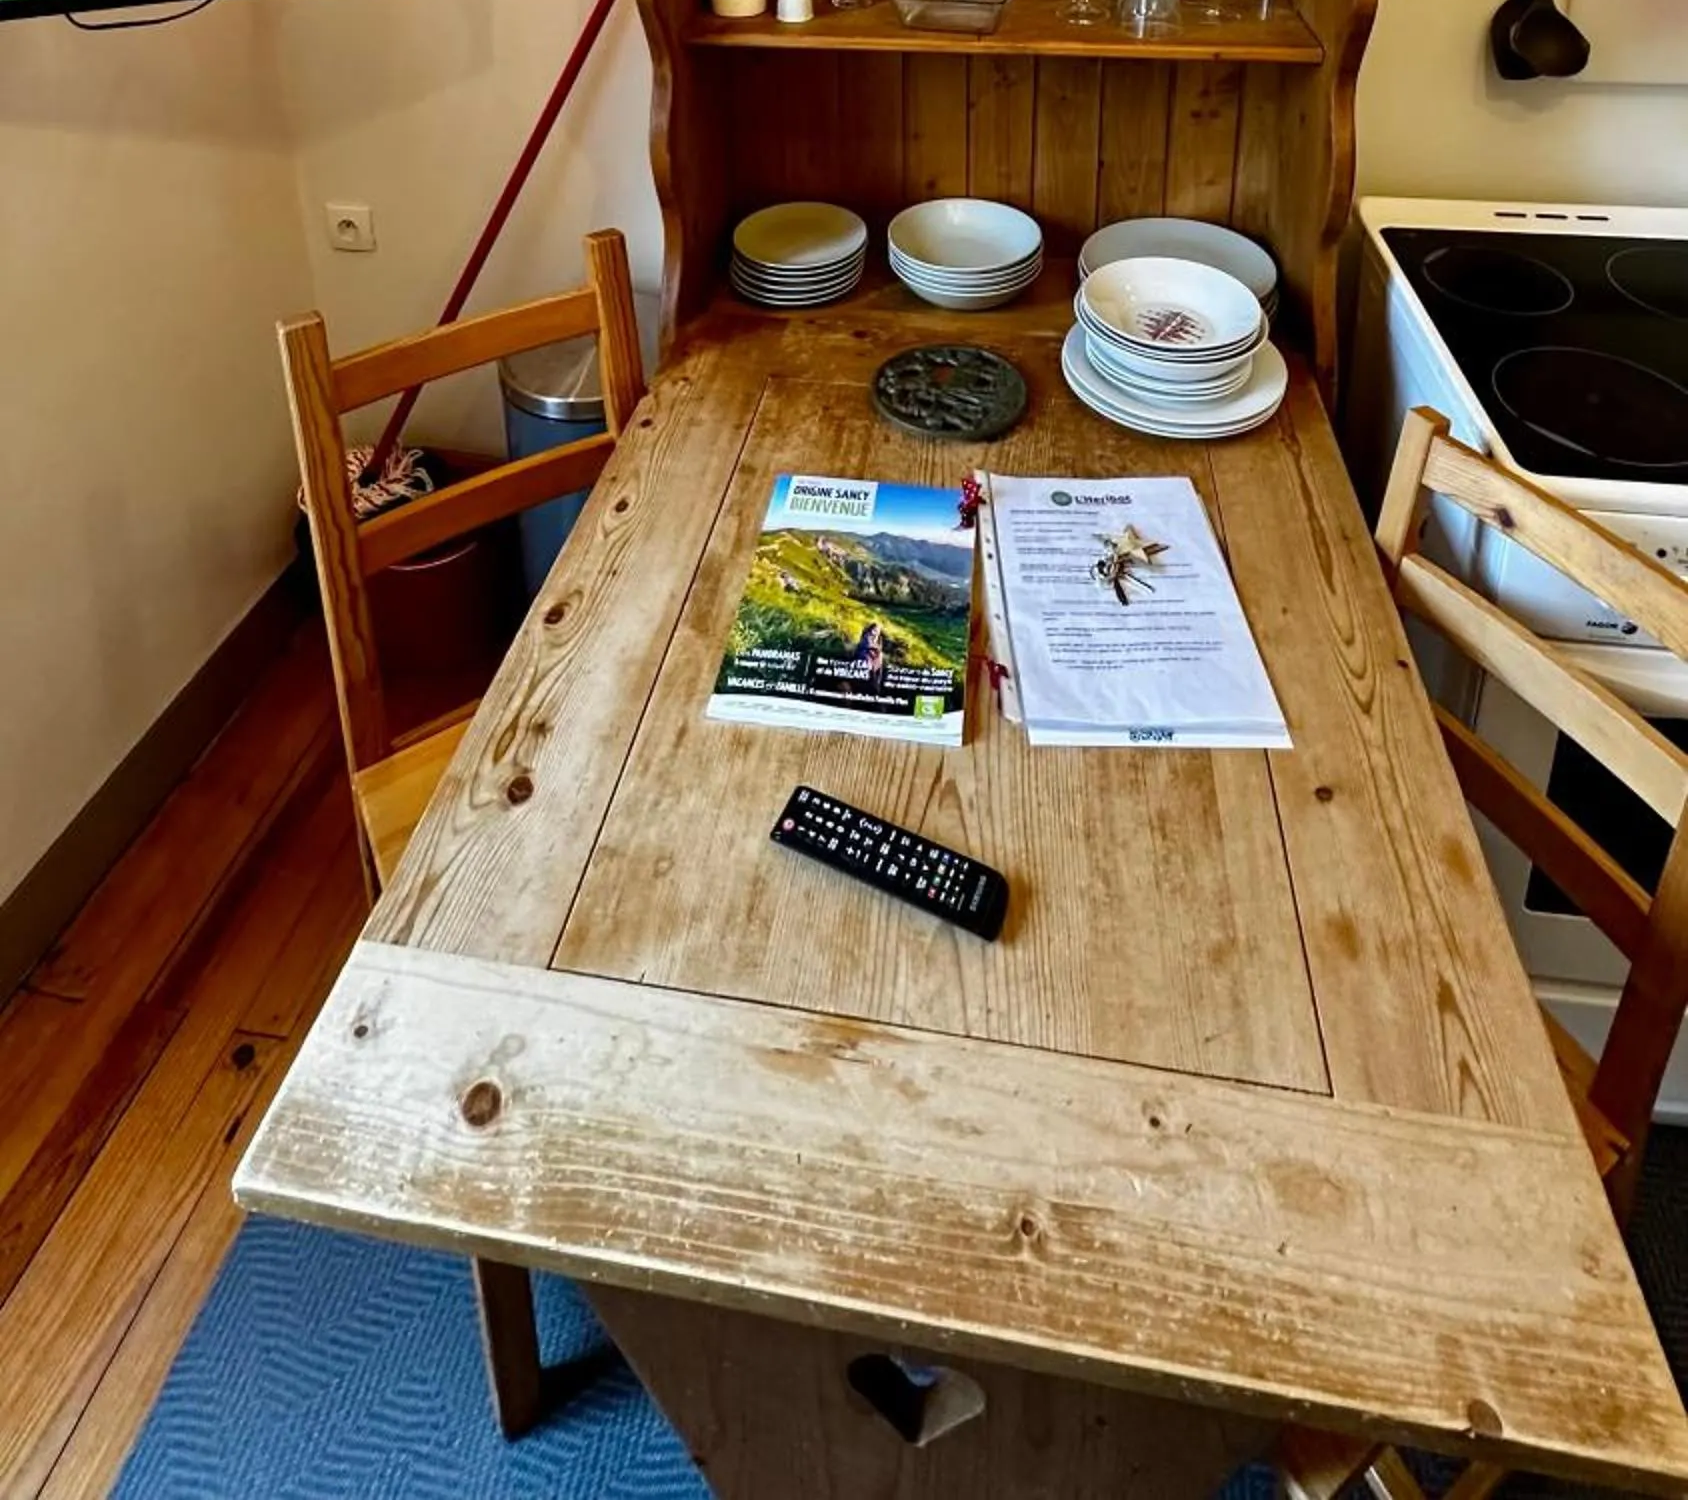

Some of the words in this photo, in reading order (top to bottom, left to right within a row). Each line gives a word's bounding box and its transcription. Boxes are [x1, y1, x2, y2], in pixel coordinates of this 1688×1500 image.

[793, 485, 833, 497] ORIGINE
[835, 488, 870, 500] SANCY
[789, 497, 869, 516] BIENVENUE
[728, 676, 765, 689] VACANCES
